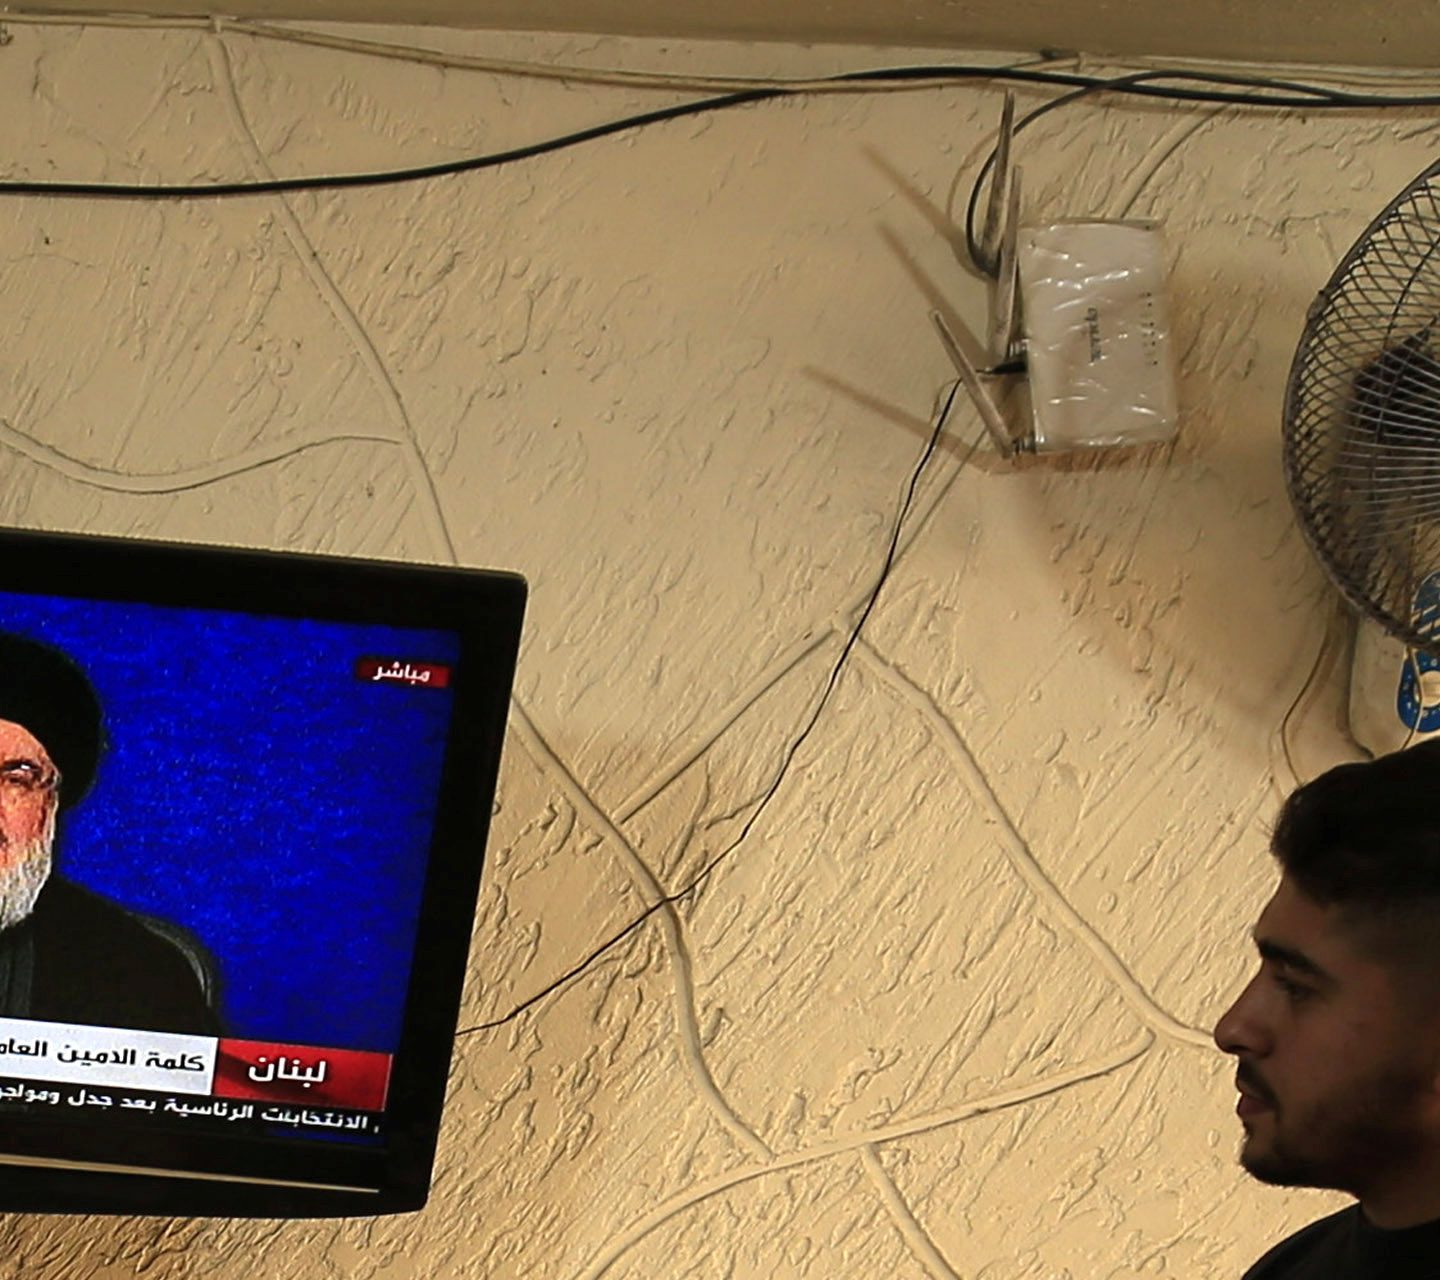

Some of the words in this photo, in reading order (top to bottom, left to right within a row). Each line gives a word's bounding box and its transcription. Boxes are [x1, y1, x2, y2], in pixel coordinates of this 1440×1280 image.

[372, 661, 431, 685] مباشر
[56, 1046, 136, 1067] الامين
[145, 1050, 205, 1072] كلمة
[247, 1055, 326, 1087] لبنان
[67, 1088, 113, 1107] جدل
[120, 1096, 157, 1114] بعد
